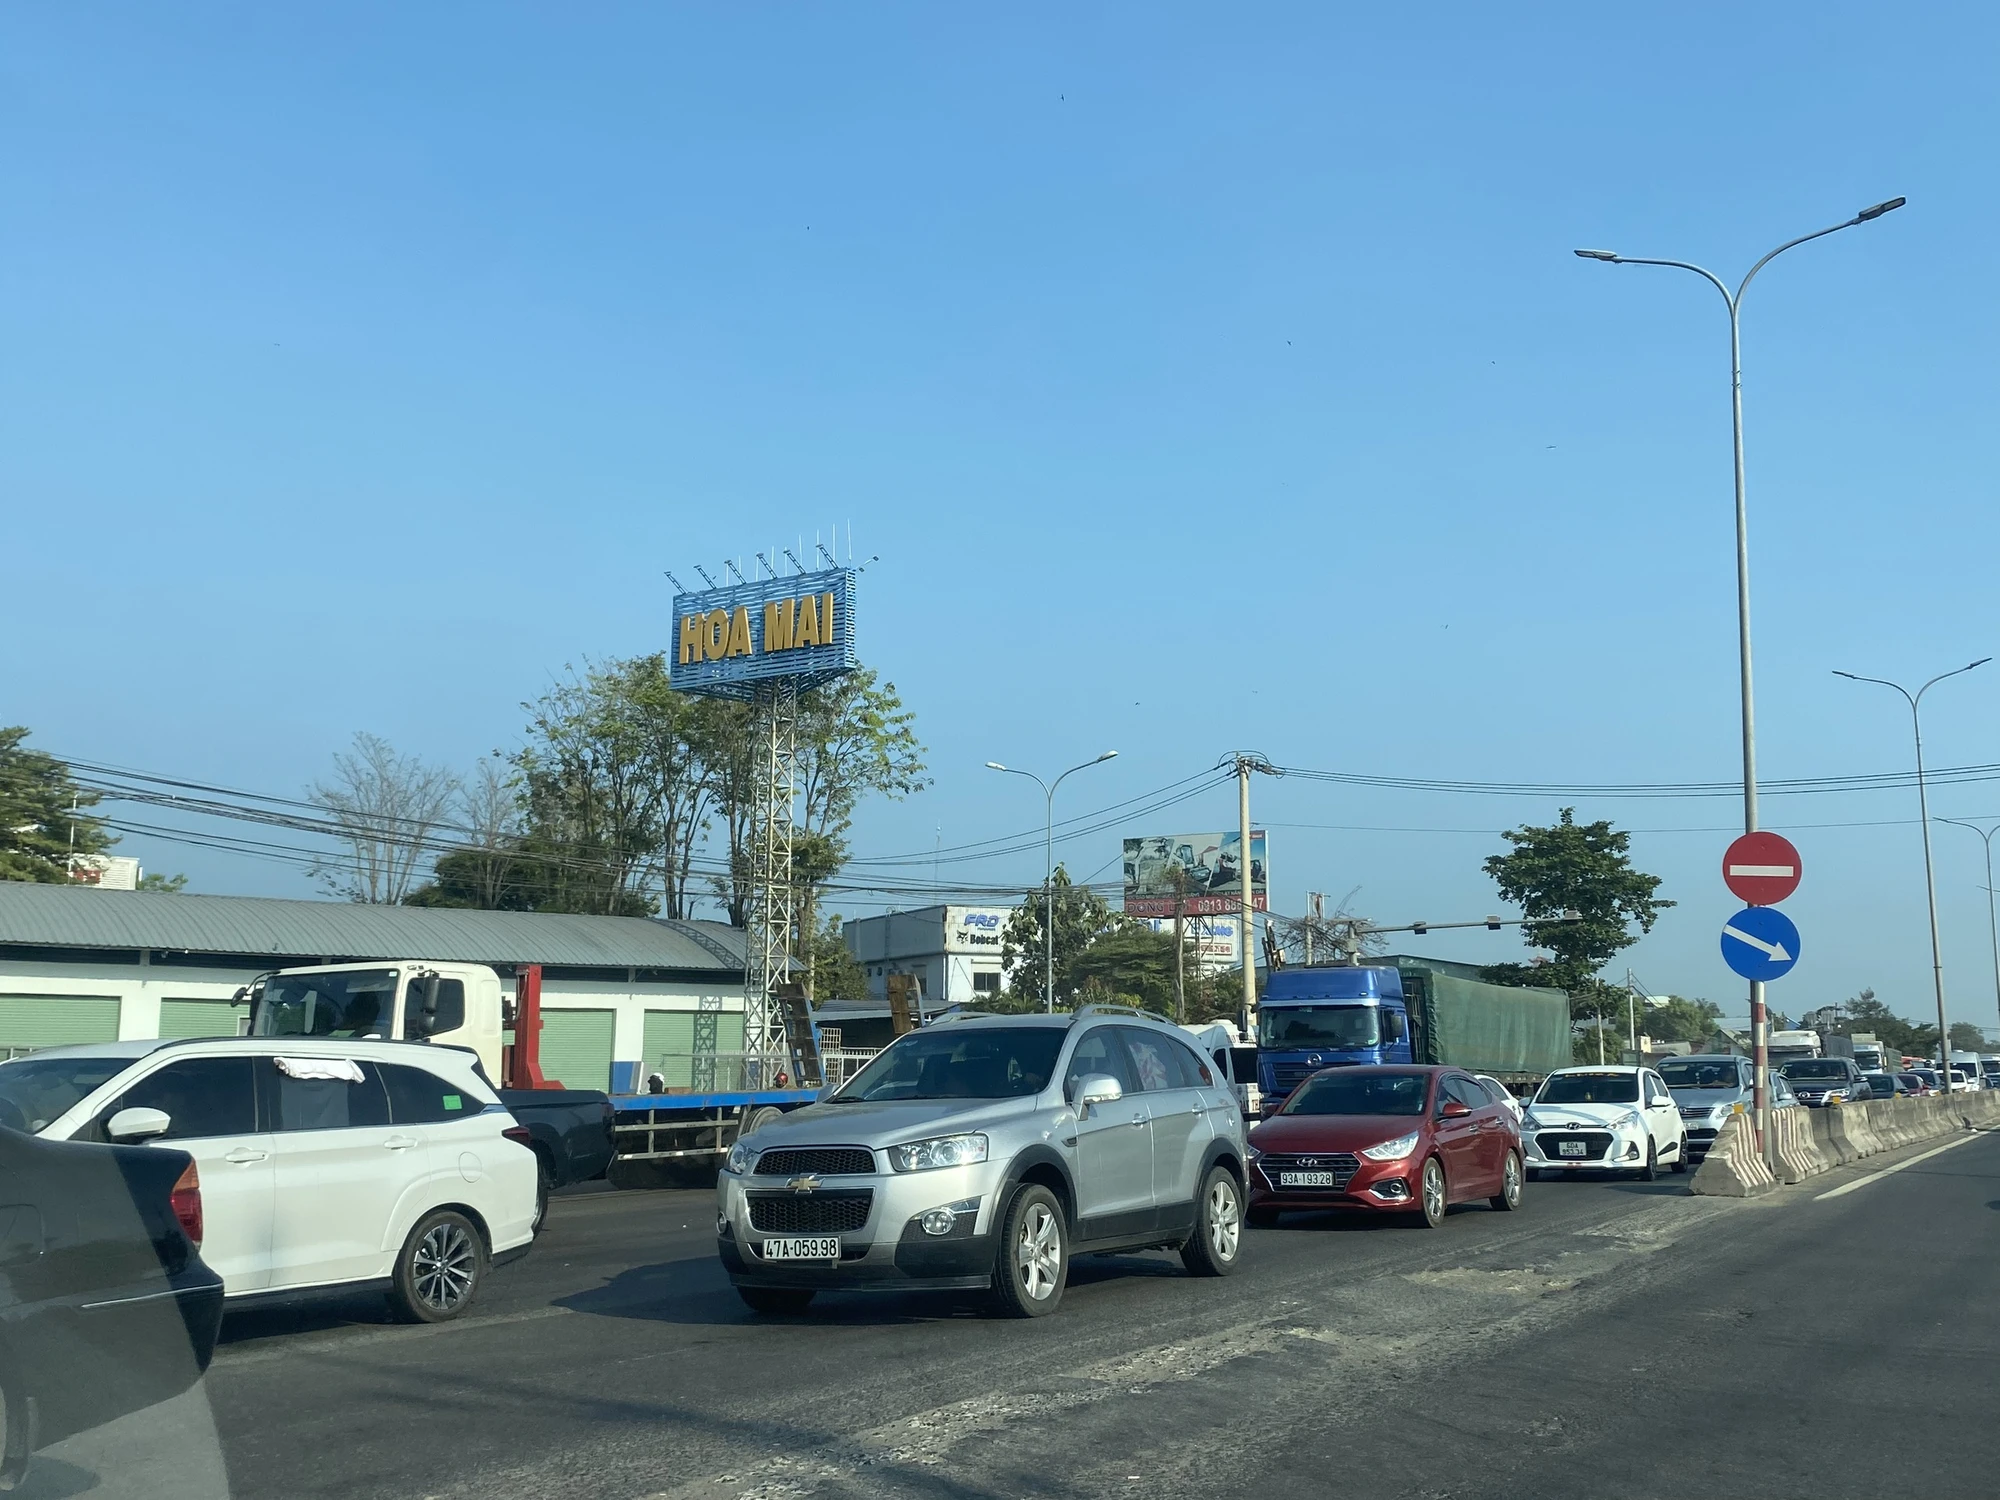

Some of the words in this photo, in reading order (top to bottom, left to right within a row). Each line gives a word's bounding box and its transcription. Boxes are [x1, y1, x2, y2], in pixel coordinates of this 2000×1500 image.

[679, 606, 753, 664] HOA
[764, 592, 834, 652] MAI
[1197, 898, 1222, 912] 0913
[964, 914, 999, 927] FRD
[970, 934, 999, 945] Bobcat
[766, 1239, 837, 1257] 47A-059.98
